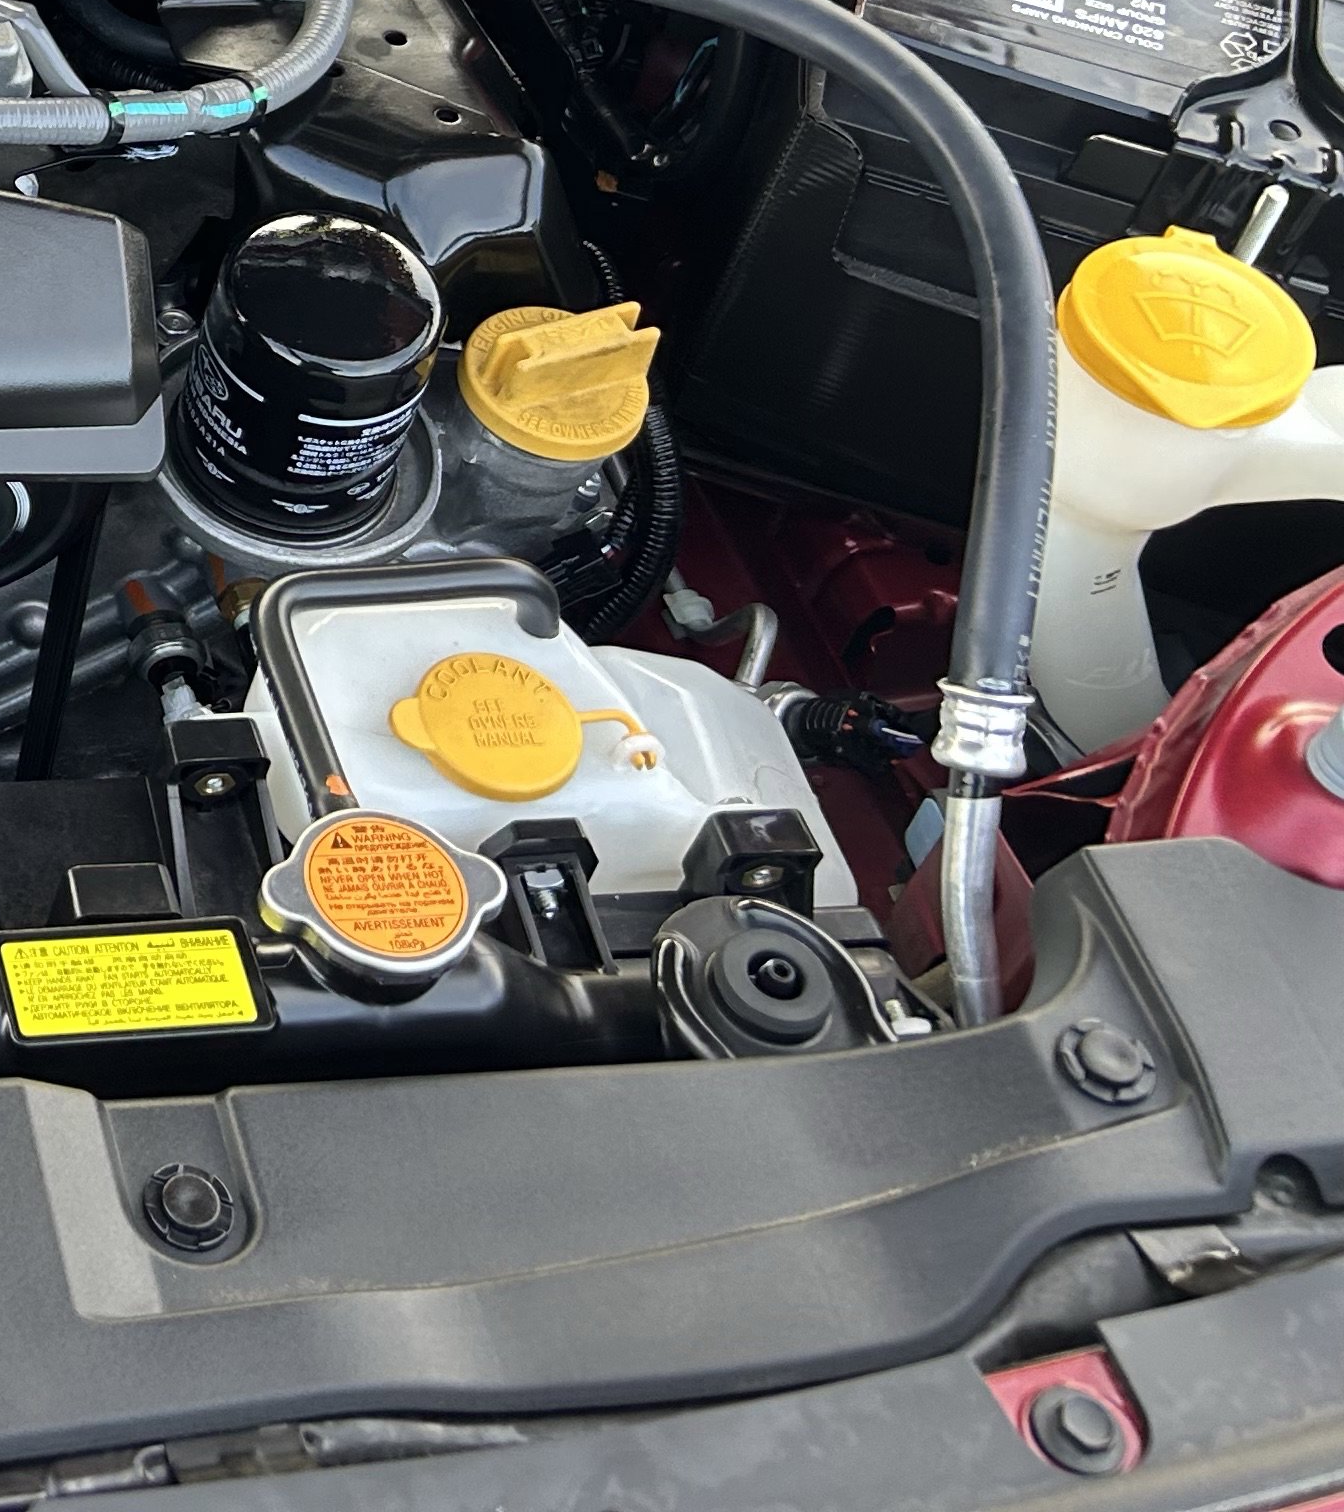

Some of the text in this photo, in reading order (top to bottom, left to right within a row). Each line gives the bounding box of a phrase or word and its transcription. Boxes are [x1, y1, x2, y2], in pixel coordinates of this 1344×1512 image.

[1074, 8, 1165, 40] 620 AMPS
[1116, 8, 1166, 26] GROUP
[1011, 3, 1164, 51] COLD CRANKING AMPS
[471, 310, 537, 353] ENGINE
[518, 412, 547, 434] SEE
[612, 384, 644, 428] MANUAL
[426, 657, 552, 700] COOLANT
[473, 731, 545, 747] MANUAL
[351, 833, 410, 843] WARNING
[321, 870, 443, 883] NEVER OPEN WHEN HOT
[338, 884, 369, 892] JAMAIS
[372, 882, 405, 890] OUVRIR
[354, 917, 445, 931] AVERTISSEMENT
[53, 945, 89, 956] CAUTION
[94, 941, 139, 954] ATTENTION
